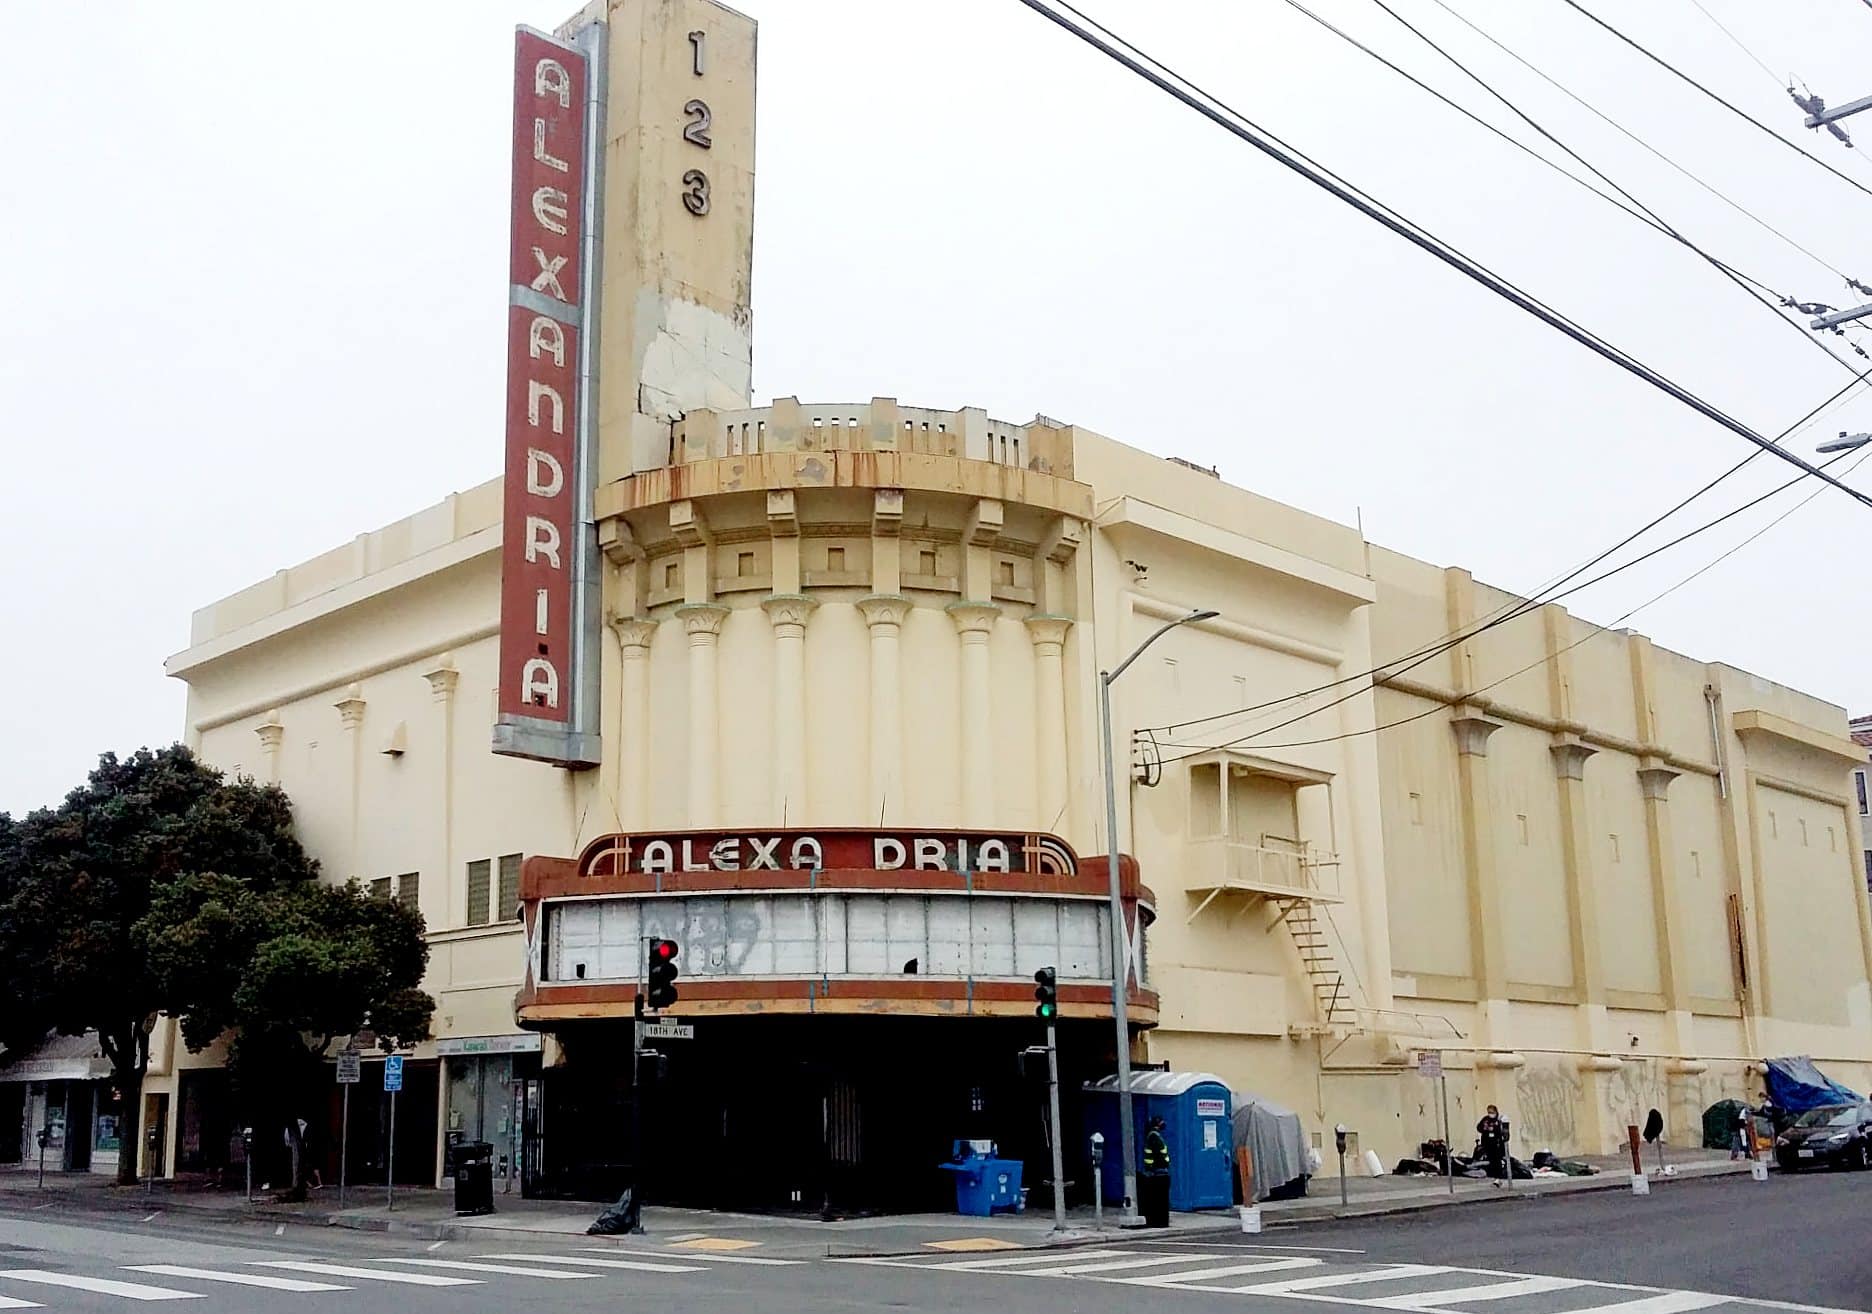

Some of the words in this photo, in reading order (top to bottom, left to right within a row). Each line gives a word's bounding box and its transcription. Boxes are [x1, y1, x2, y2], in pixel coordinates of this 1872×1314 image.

[521, 58, 571, 709] ALEXANDRIA
[873, 837, 1011, 874] DRIA
[673, 1026, 688, 1036] AVE
